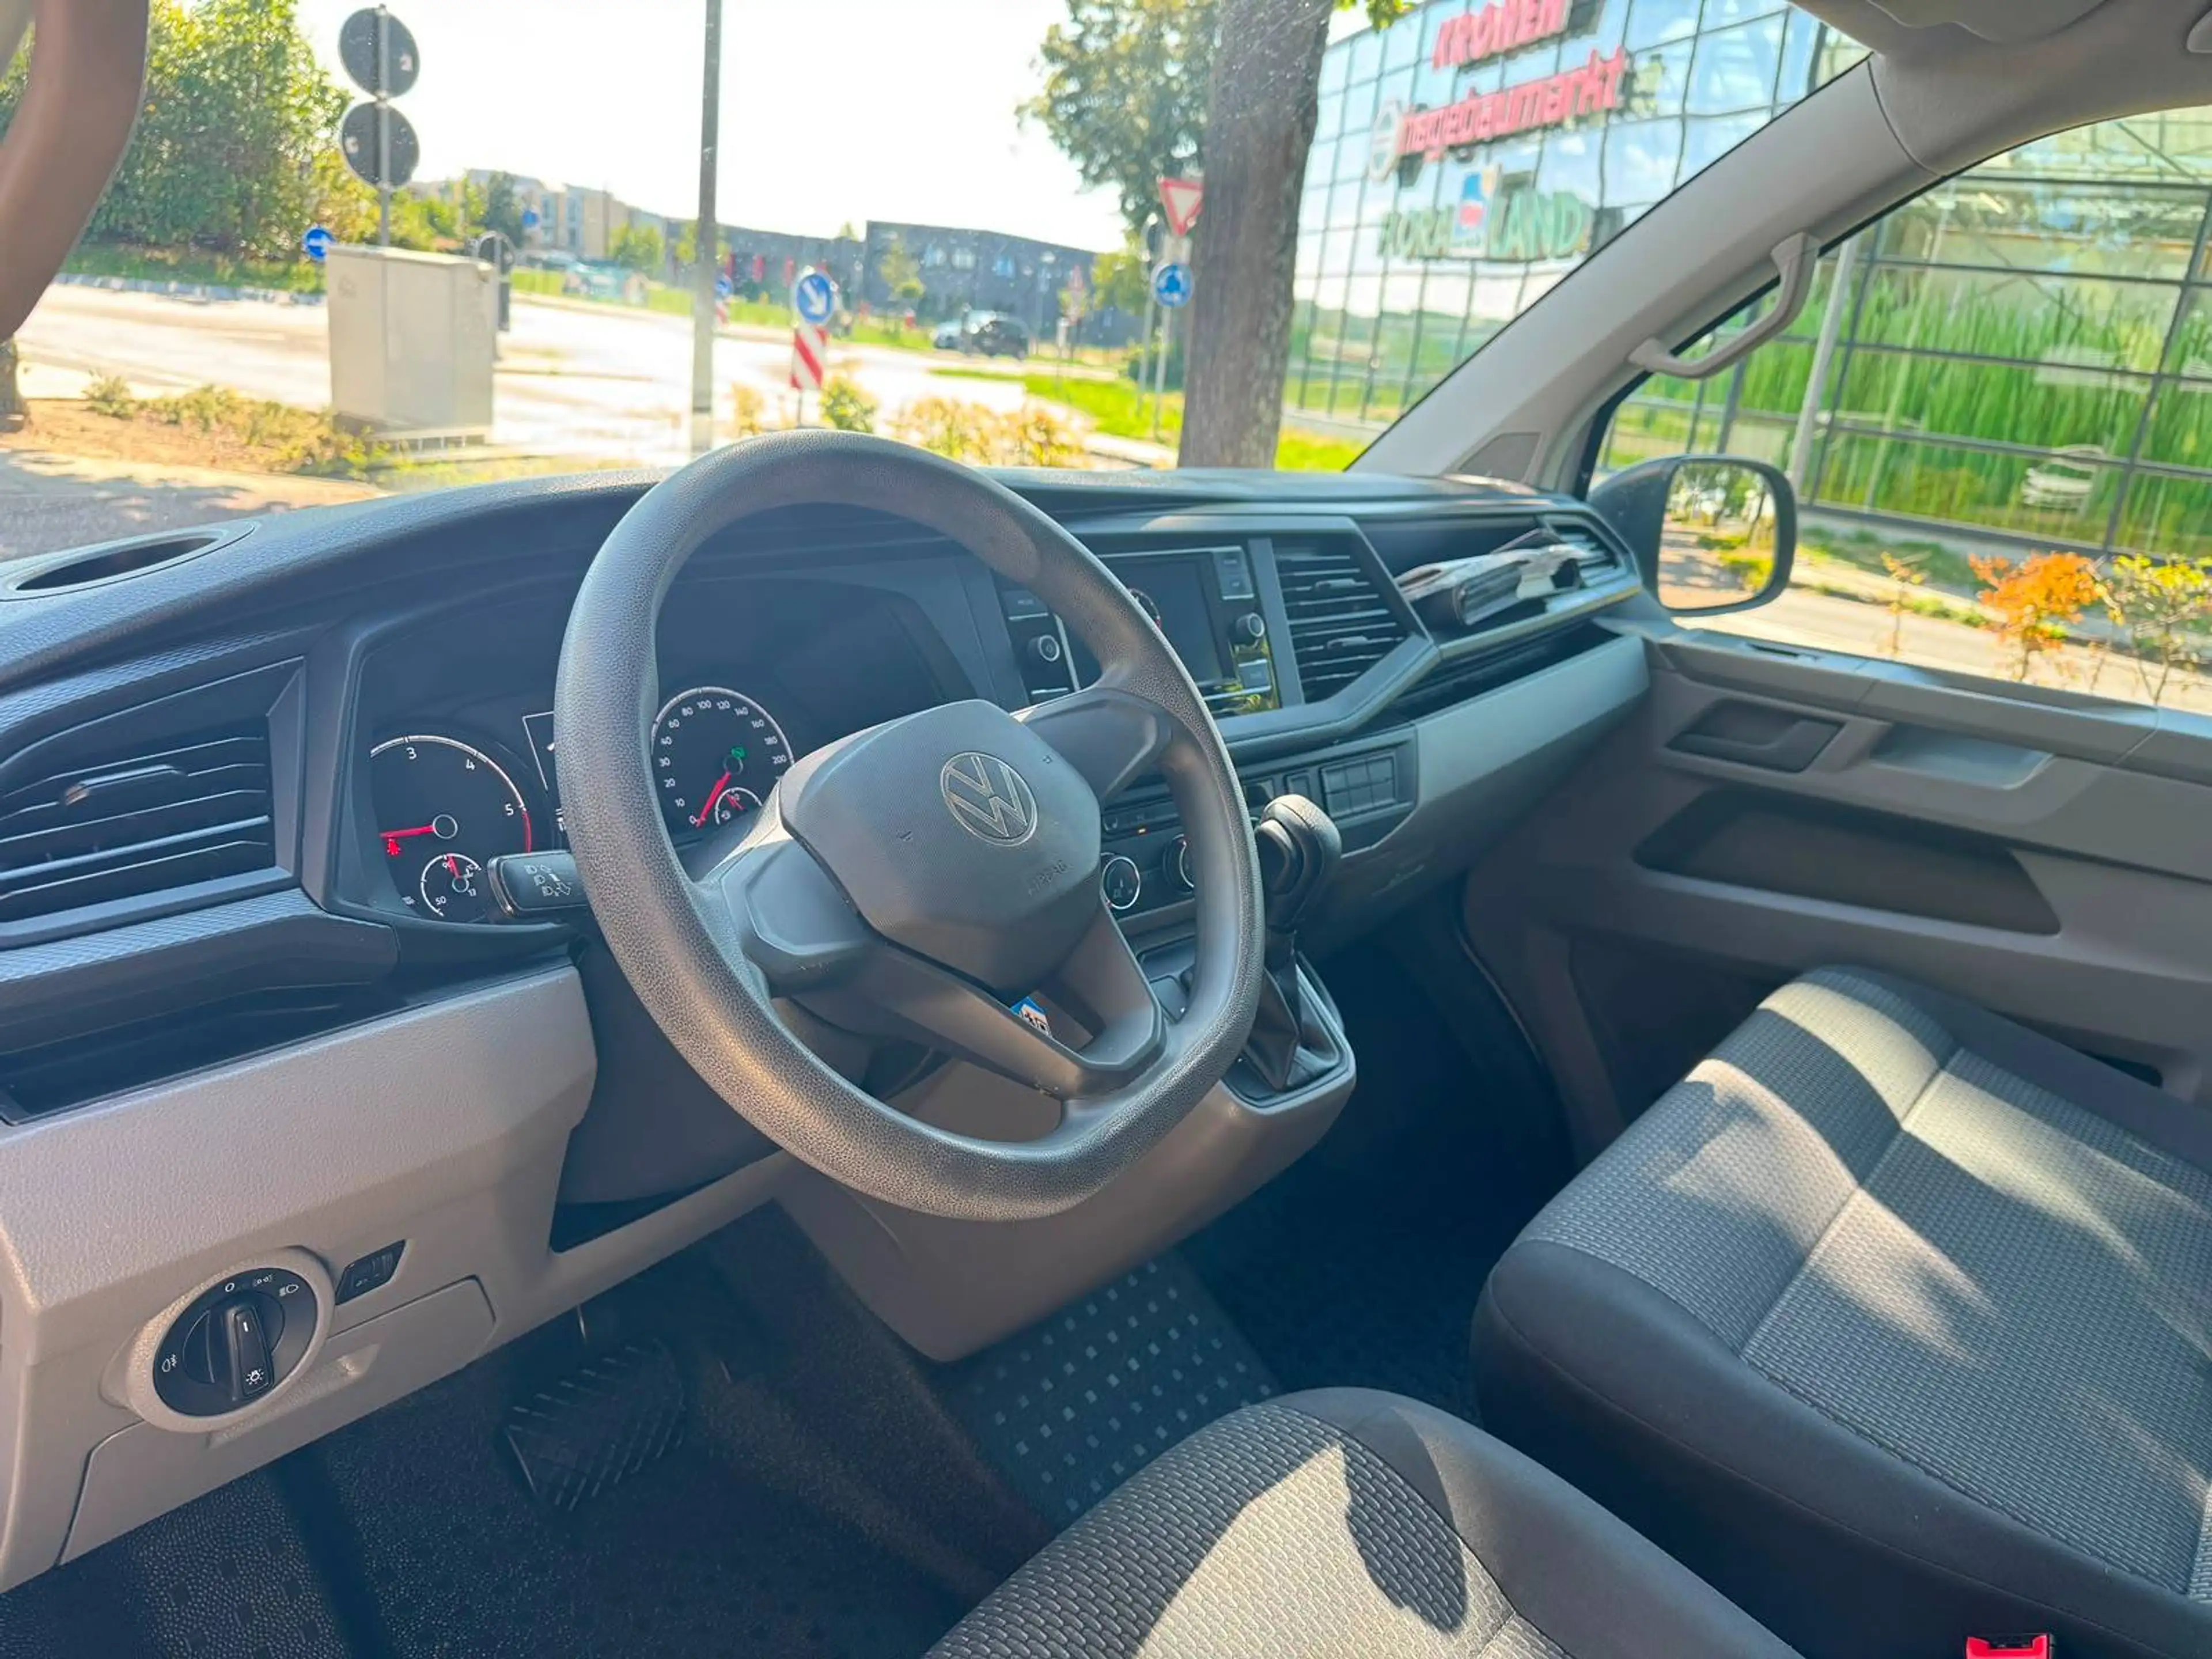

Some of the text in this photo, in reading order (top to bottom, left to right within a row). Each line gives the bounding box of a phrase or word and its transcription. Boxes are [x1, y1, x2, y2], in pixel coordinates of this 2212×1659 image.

[697, 700, 711, 709] 100
[717, 700, 730, 710] 120
[734, 706, 749, 716] 140
[751, 719, 764, 729] 160
[764, 736, 778, 745] 180
[406, 747, 417, 760] 3
[465, 759, 475, 770] 4
[659, 756, 671, 767] 30
[772, 755, 787, 765] 200
[664, 778, 676, 787] 20
[675, 798, 685, 808] 10
[505, 804, 514, 816] 5
[435, 896, 446, 906] 50
